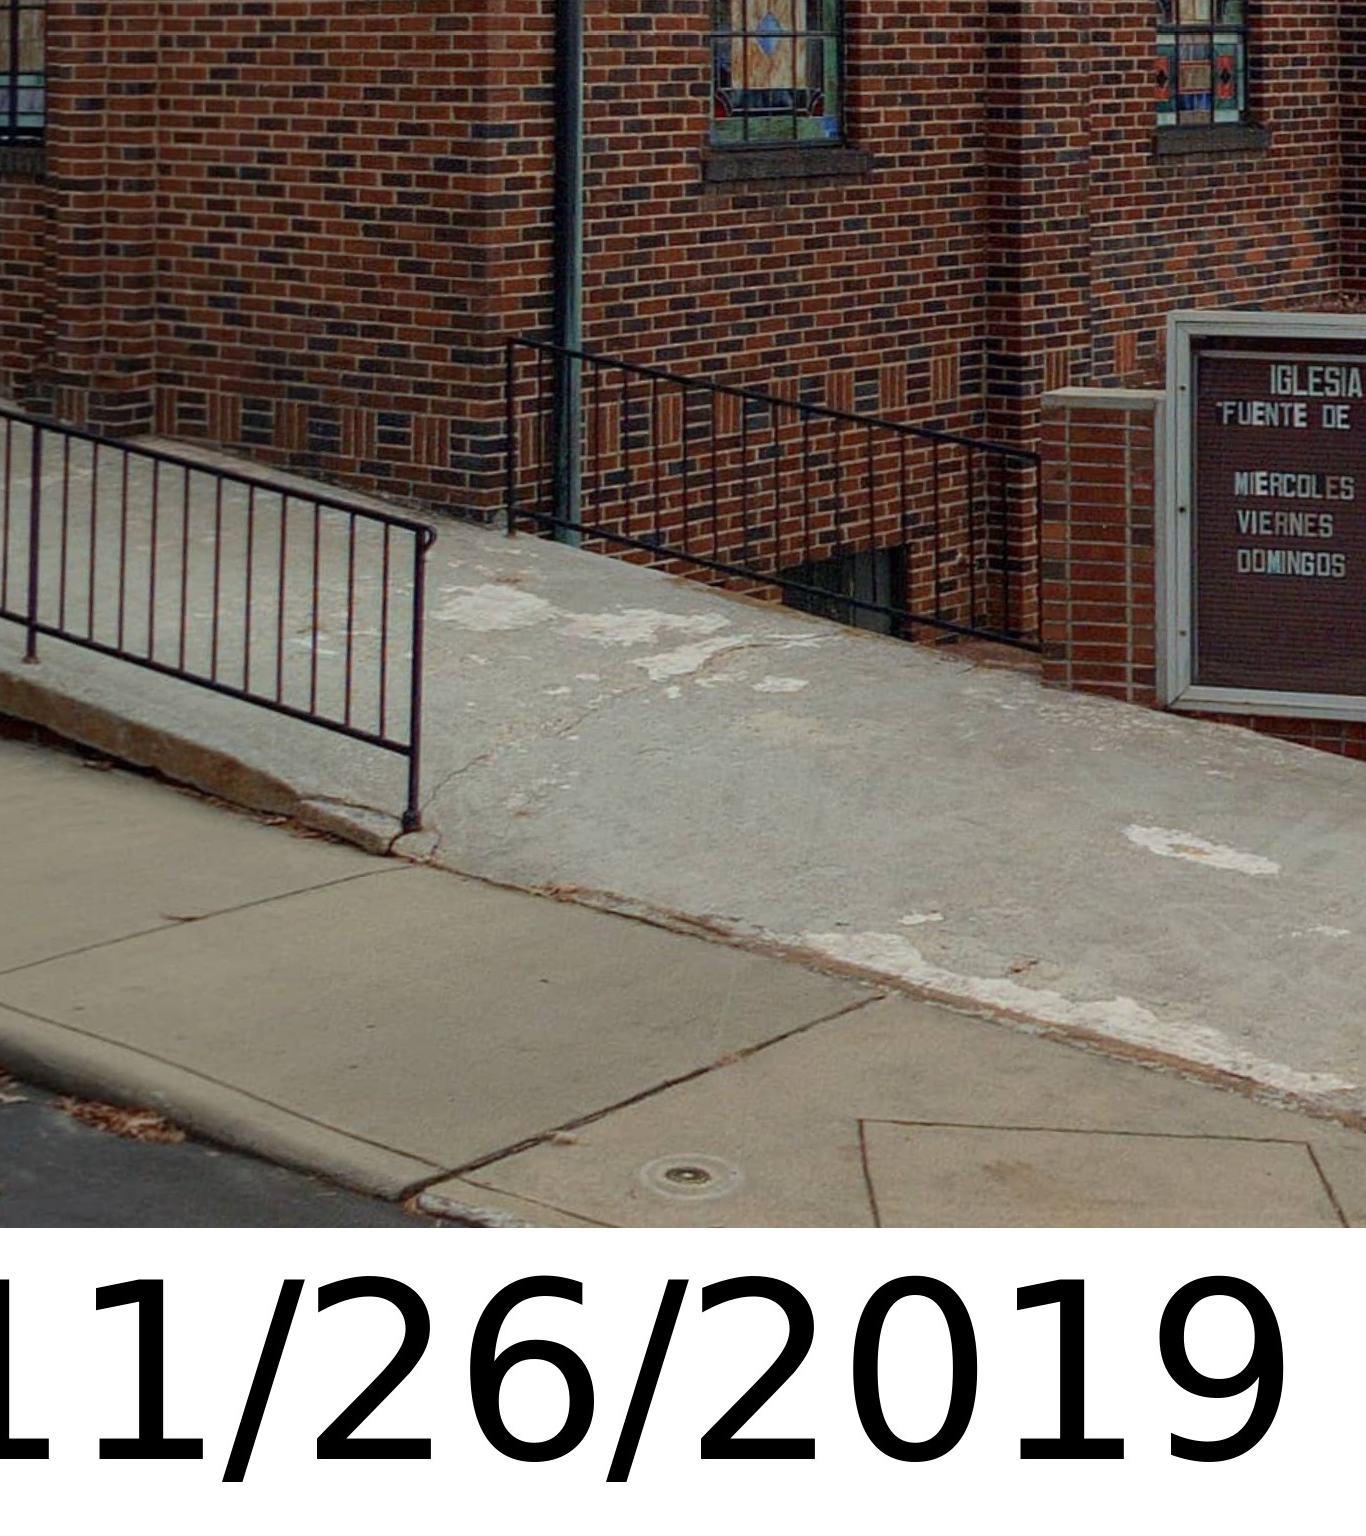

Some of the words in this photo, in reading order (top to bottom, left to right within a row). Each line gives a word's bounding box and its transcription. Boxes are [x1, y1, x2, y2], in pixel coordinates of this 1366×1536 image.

[1270, 365, 1364, 397] IGLESIA
[1322, 404, 1351, 430] DE
[1235, 471, 1354, 501] MIERCOLES
[1237, 510, 1334, 538] VIERNES
[1237, 549, 1346, 578] DOMINGOS
